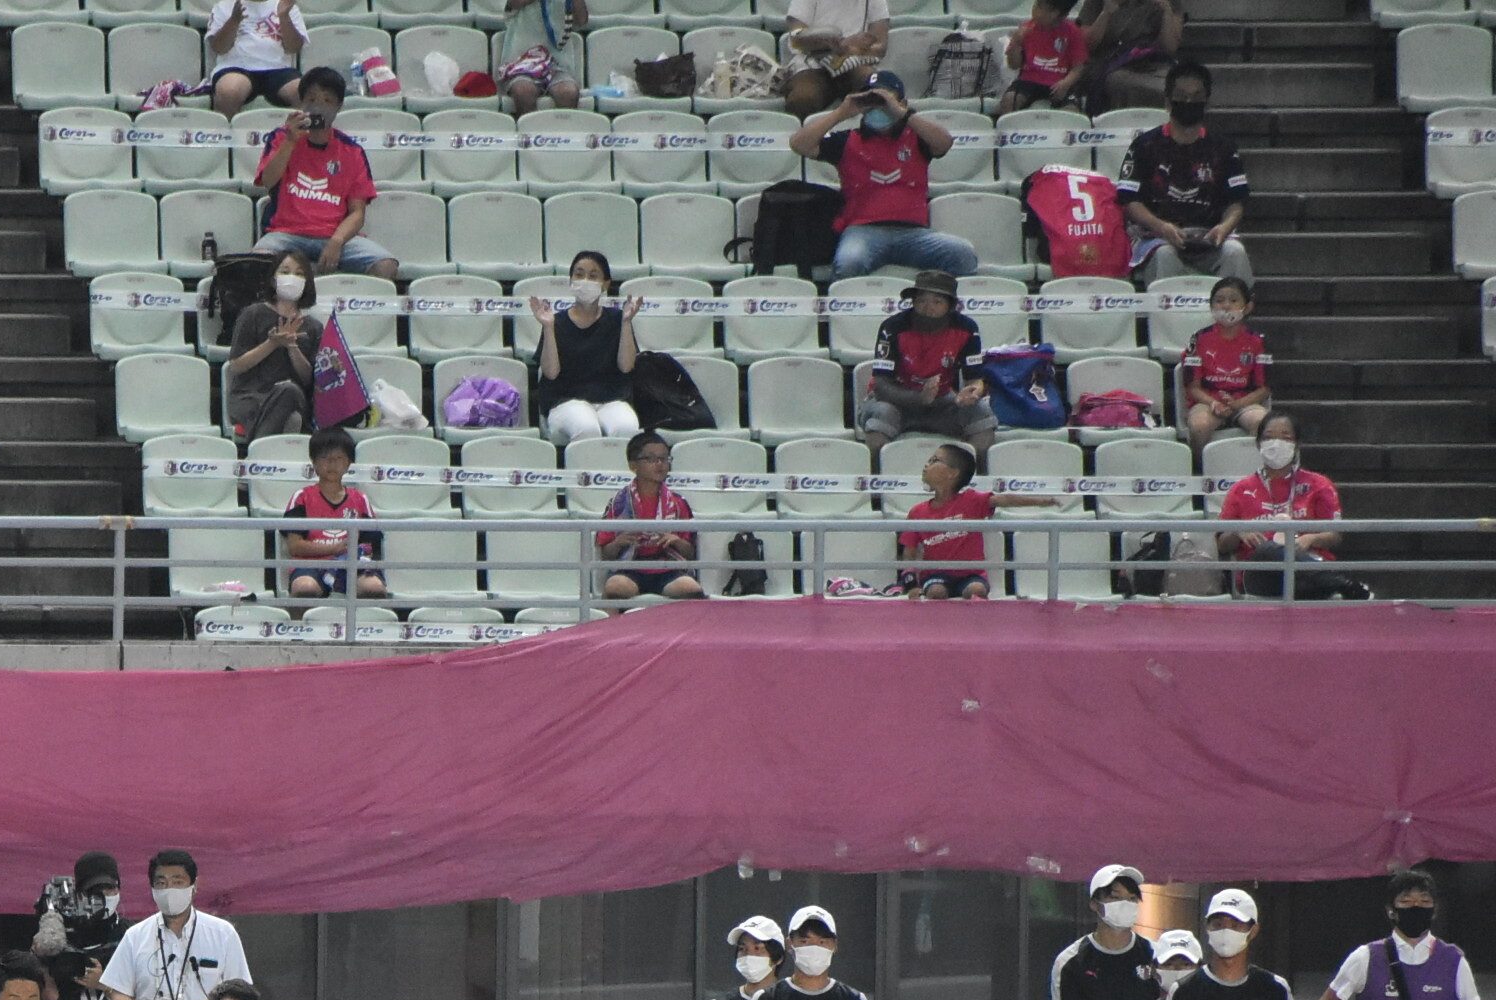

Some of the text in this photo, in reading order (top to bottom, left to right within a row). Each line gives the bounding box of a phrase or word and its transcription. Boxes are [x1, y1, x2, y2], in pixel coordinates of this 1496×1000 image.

[288, 183, 341, 206] YANMAR
[1067, 175, 1094, 222] 5
[1068, 224, 1104, 237] FUJITA
